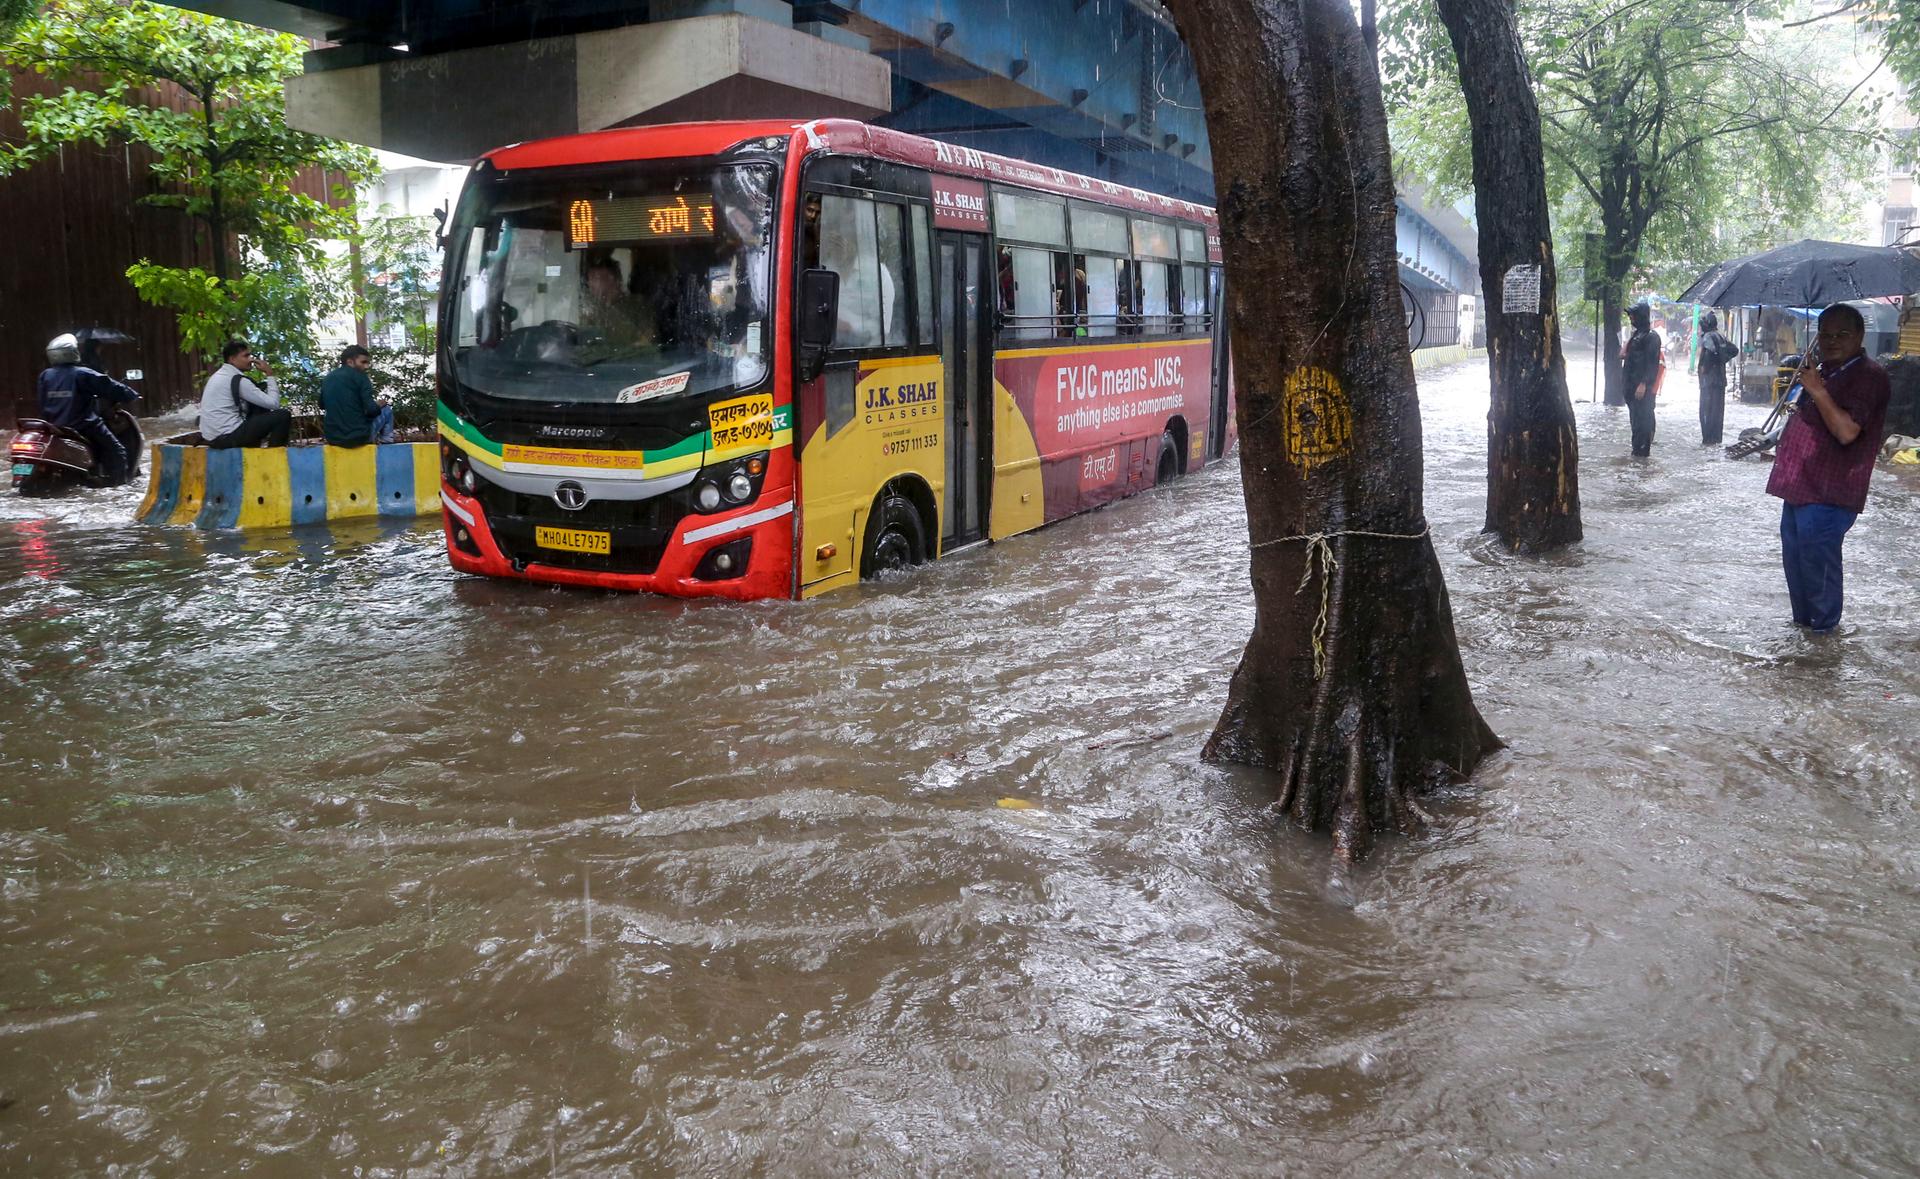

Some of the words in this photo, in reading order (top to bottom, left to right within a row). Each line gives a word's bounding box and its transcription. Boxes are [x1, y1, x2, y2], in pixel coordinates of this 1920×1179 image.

[954, 146, 963, 166] &
[934, 190, 955, 207] J.K.
[955, 193, 984, 211] SHAH
[648, 196, 691, 234] ठाणे
[935, 208, 985, 221] CLASSES
[1057, 364, 1098, 403] FYJC
[1101, 365, 1147, 396] means
[1150, 356, 1184, 389] JKSC,
[865, 387, 895, 409] J.K.
[897, 381, 937, 404] SHAH
[865, 405, 937, 424] CLASSES
[1057, 407, 1101, 434] anything
[1102, 402, 1121, 423] else
[1122, 400, 1130, 420] is
[1131, 402, 1136, 418] a
[1137, 391, 1185, 416] compromise.
[542, 425, 604, 437] Marcopolo
[890, 440, 910, 454] 9757
[911, 437, 923, 450] 111
[924, 434, 938, 448] 333
[543, 530, 607, 550] MH04LE7975
